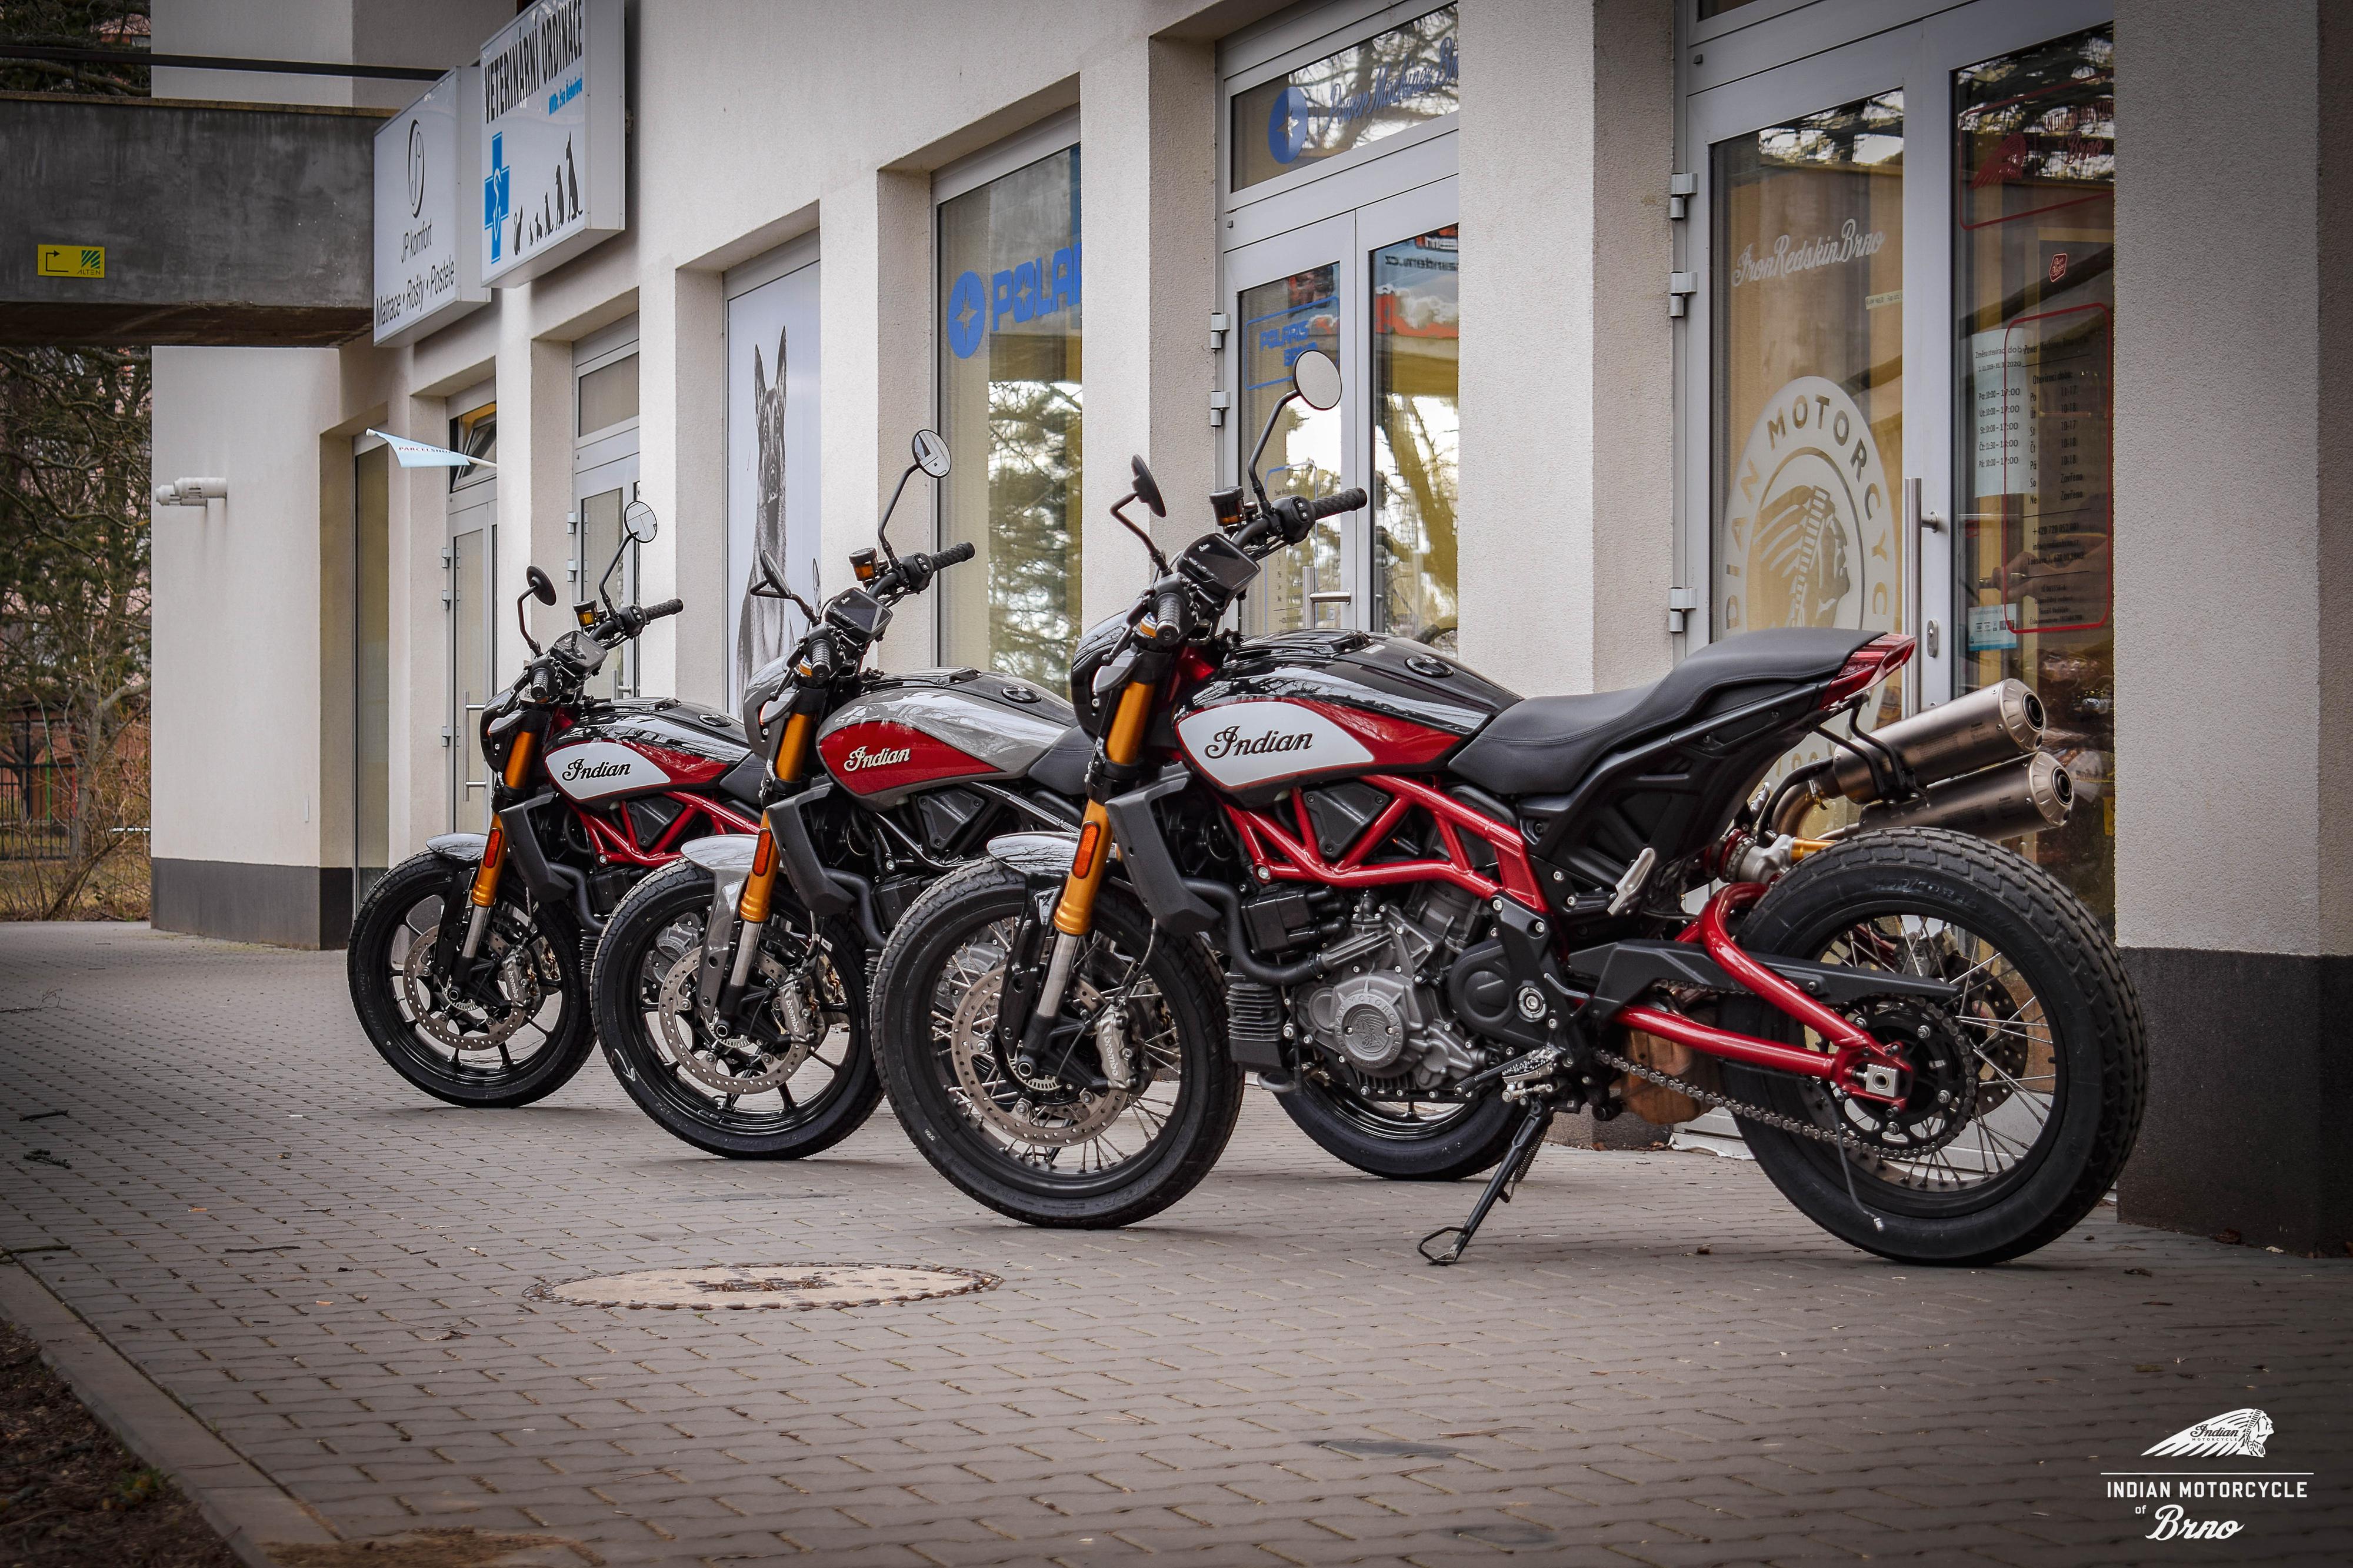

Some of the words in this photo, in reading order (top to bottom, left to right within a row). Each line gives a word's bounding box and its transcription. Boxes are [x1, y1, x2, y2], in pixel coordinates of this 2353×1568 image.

[485, 14, 539, 124] VETERINÁRNÍ
[542, 0, 582, 85] ORDINACE
[401, 232, 409, 263] JP
[410, 218, 432, 258] komfort
[376, 293, 401, 328] Matrace
[406, 273, 424, 312] Rošty
[430, 254, 454, 298] Postele
[992, 242, 1081, 332] POLA
[844, 746, 911, 772] Indian
[1204, 725, 1313, 759] Indian
[562, 758, 631, 781] Indian
[508, 970, 518, 998] brembo
[785, 999, 799, 1032] brembo
[1104, 1036, 1118, 1076] brembo
